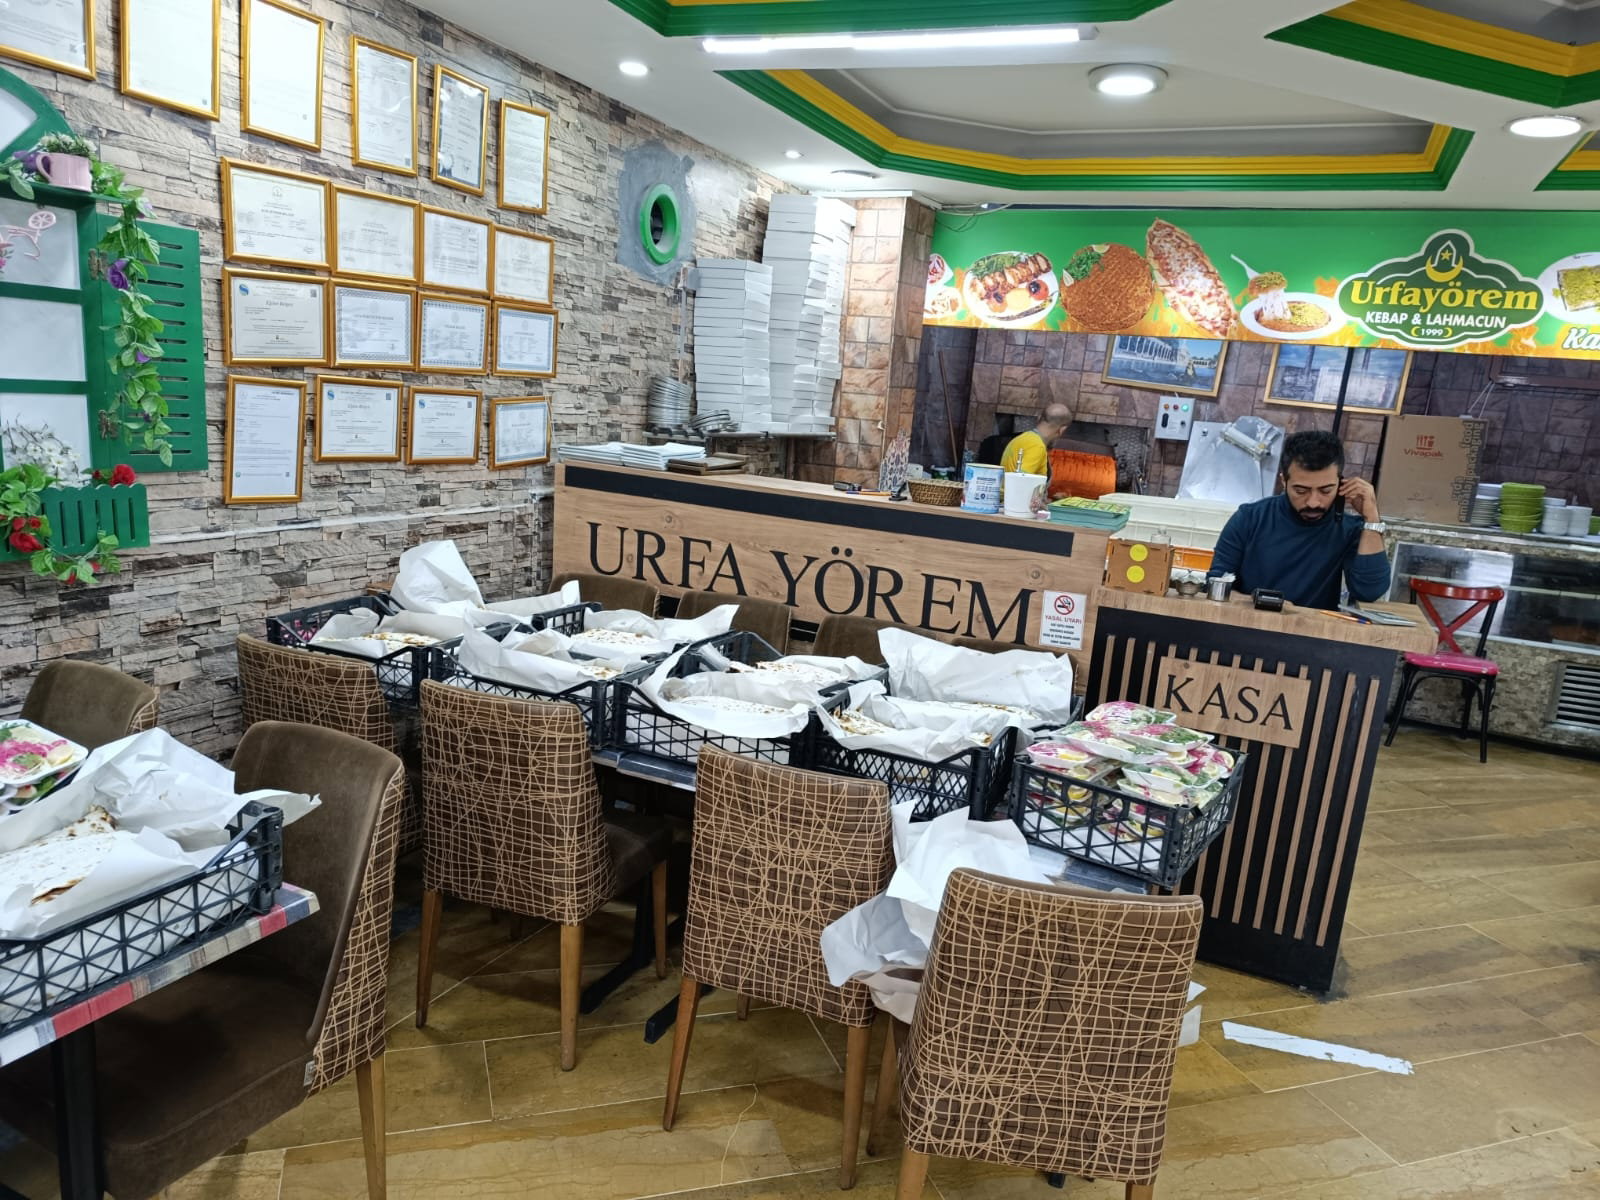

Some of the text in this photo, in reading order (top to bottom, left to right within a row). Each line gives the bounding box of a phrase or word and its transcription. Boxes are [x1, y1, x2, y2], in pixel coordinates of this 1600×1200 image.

[1350, 280, 1538, 313] Urfayörem
[1365, 310, 1507, 329] KEBAP & LAHMACUN
[1403, 448, 1444, 457] Vivapak
[586, 521, 1038, 646] URFA YÖREM
[1163, 674, 1294, 731] KASA
